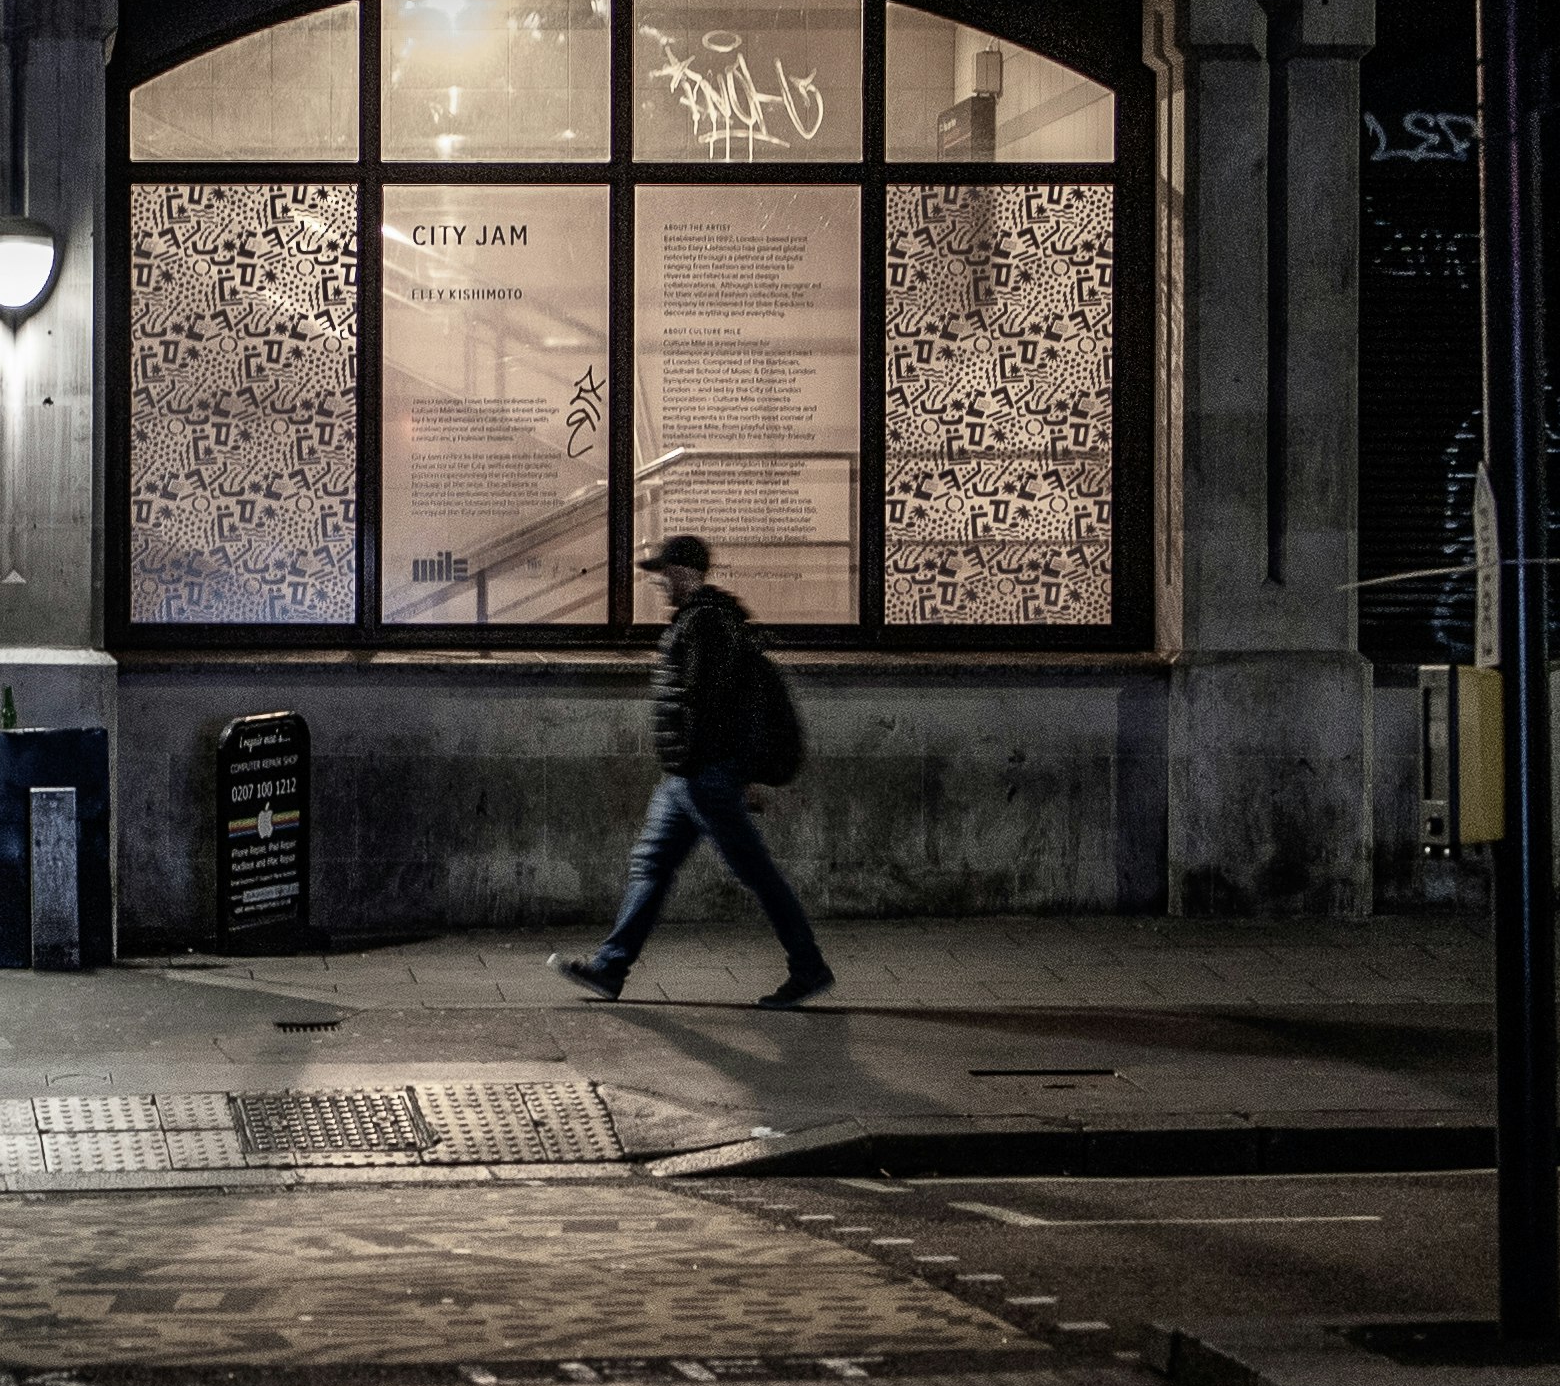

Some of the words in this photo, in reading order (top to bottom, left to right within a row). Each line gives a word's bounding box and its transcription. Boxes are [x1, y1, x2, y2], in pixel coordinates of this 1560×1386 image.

[412, 225, 467, 245] CITY
[476, 225, 528, 245] JAM
[449, 288, 523, 300] KISHIMOTO
[230, 760, 261, 774] COMPUTER
[262, 757, 282, 769] REPAIR
[231, 784, 253, 803] 0207
[257, 781, 273, 799] 100
[276, 777, 297, 796] 1212
